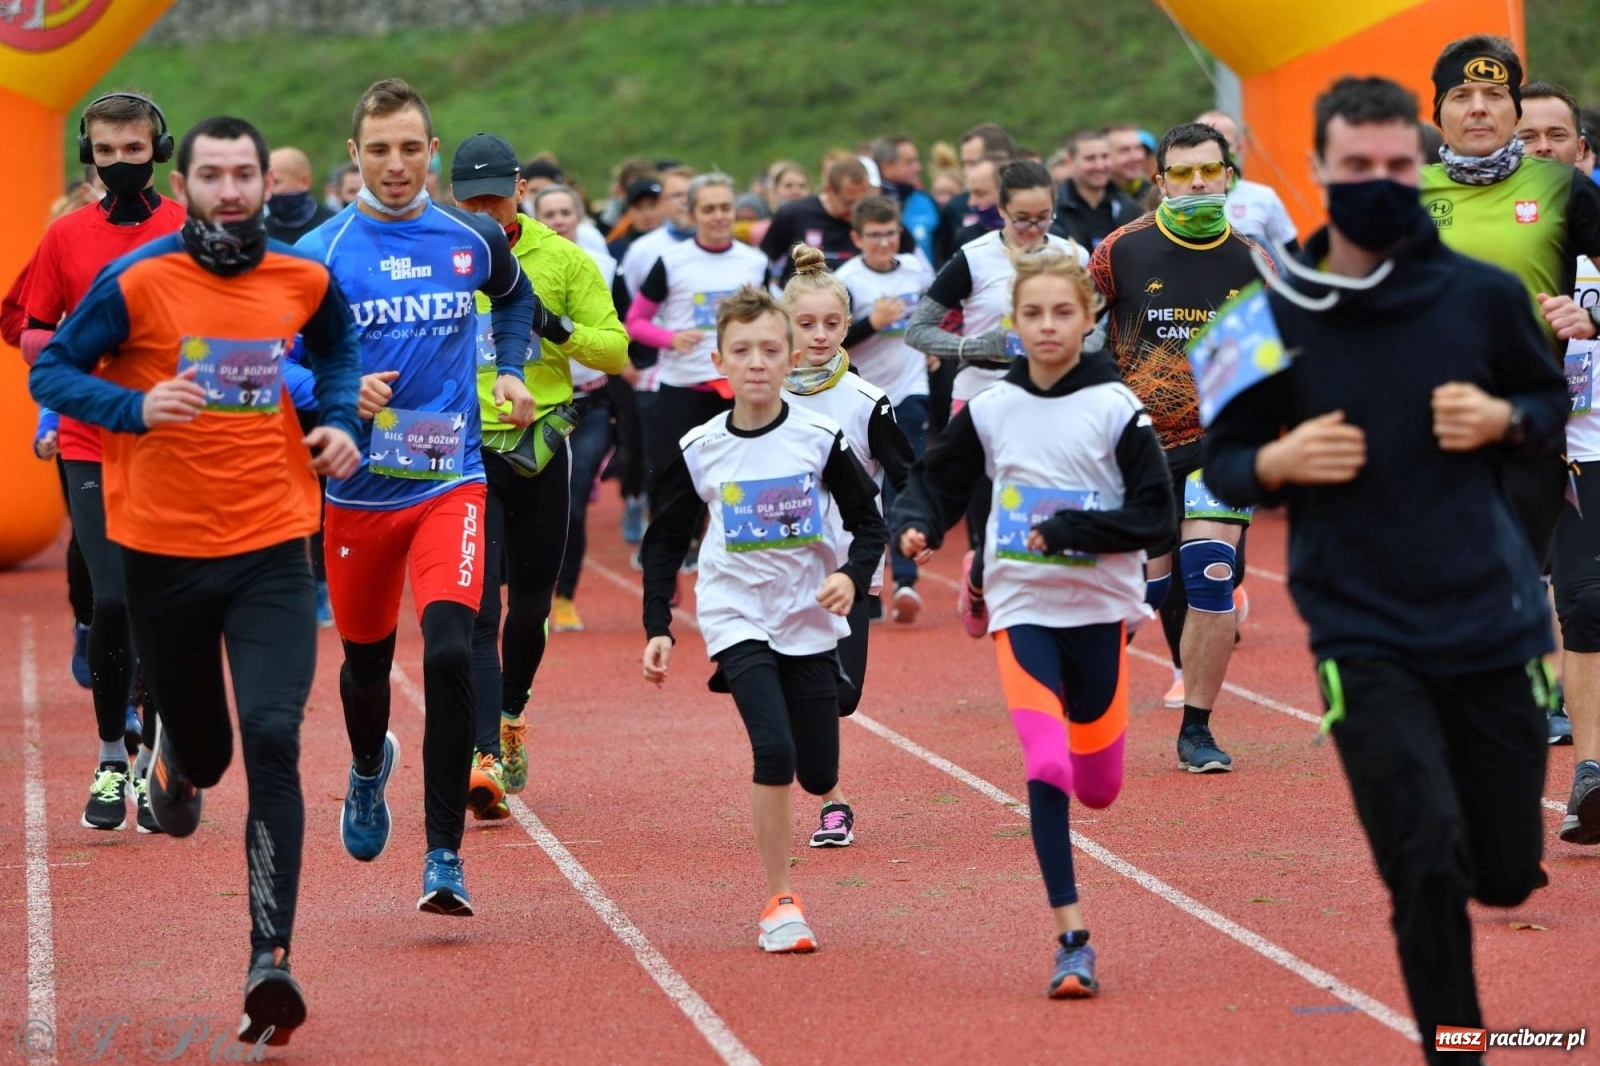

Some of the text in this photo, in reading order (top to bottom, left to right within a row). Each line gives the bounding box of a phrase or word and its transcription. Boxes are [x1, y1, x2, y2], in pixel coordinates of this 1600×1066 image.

[349, 291, 473, 327] UNNER
[1147, 308, 1218, 323] PIERUNS
[358, 327, 428, 340] KO-OKNA
[220, 365, 239, 376] DLA
[238, 389, 272, 408] 072
[1571, 395, 1586, 411] 73
[384, 431, 404, 441] BIEG
[408, 434, 424, 444] DLA
[429, 457, 455, 470] 110
[733, 504, 753, 515] BIEG
[757, 504, 774, 514] DLA
[779, 518, 813, 537] 056
[457, 502, 477, 587] POLSKA
